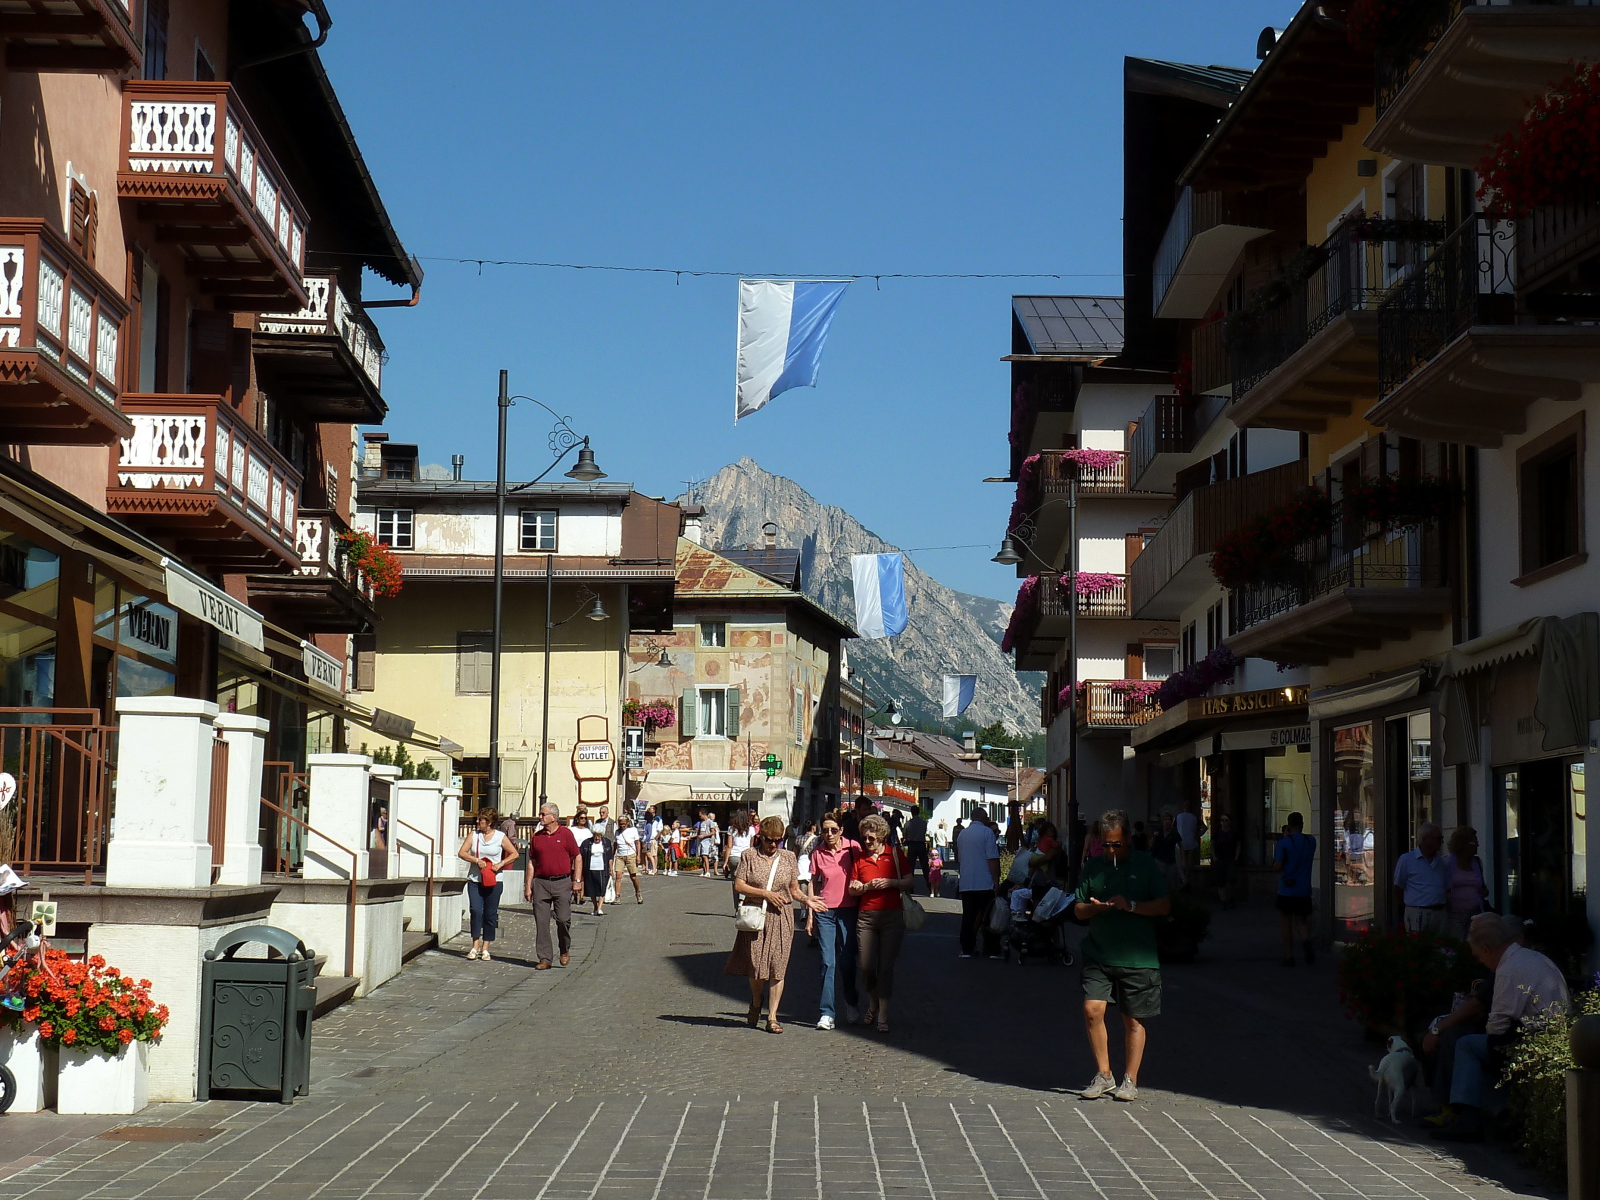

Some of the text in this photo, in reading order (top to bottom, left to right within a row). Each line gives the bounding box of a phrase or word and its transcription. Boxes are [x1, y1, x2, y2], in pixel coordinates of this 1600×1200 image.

[199, 590, 240, 635] VERNI
[311, 655, 337, 687] VERNI
[1202, 697, 1229, 716] ITAS
[1279, 728, 1311, 745] COLMAR
[579, 752, 609, 760] OUTLET
